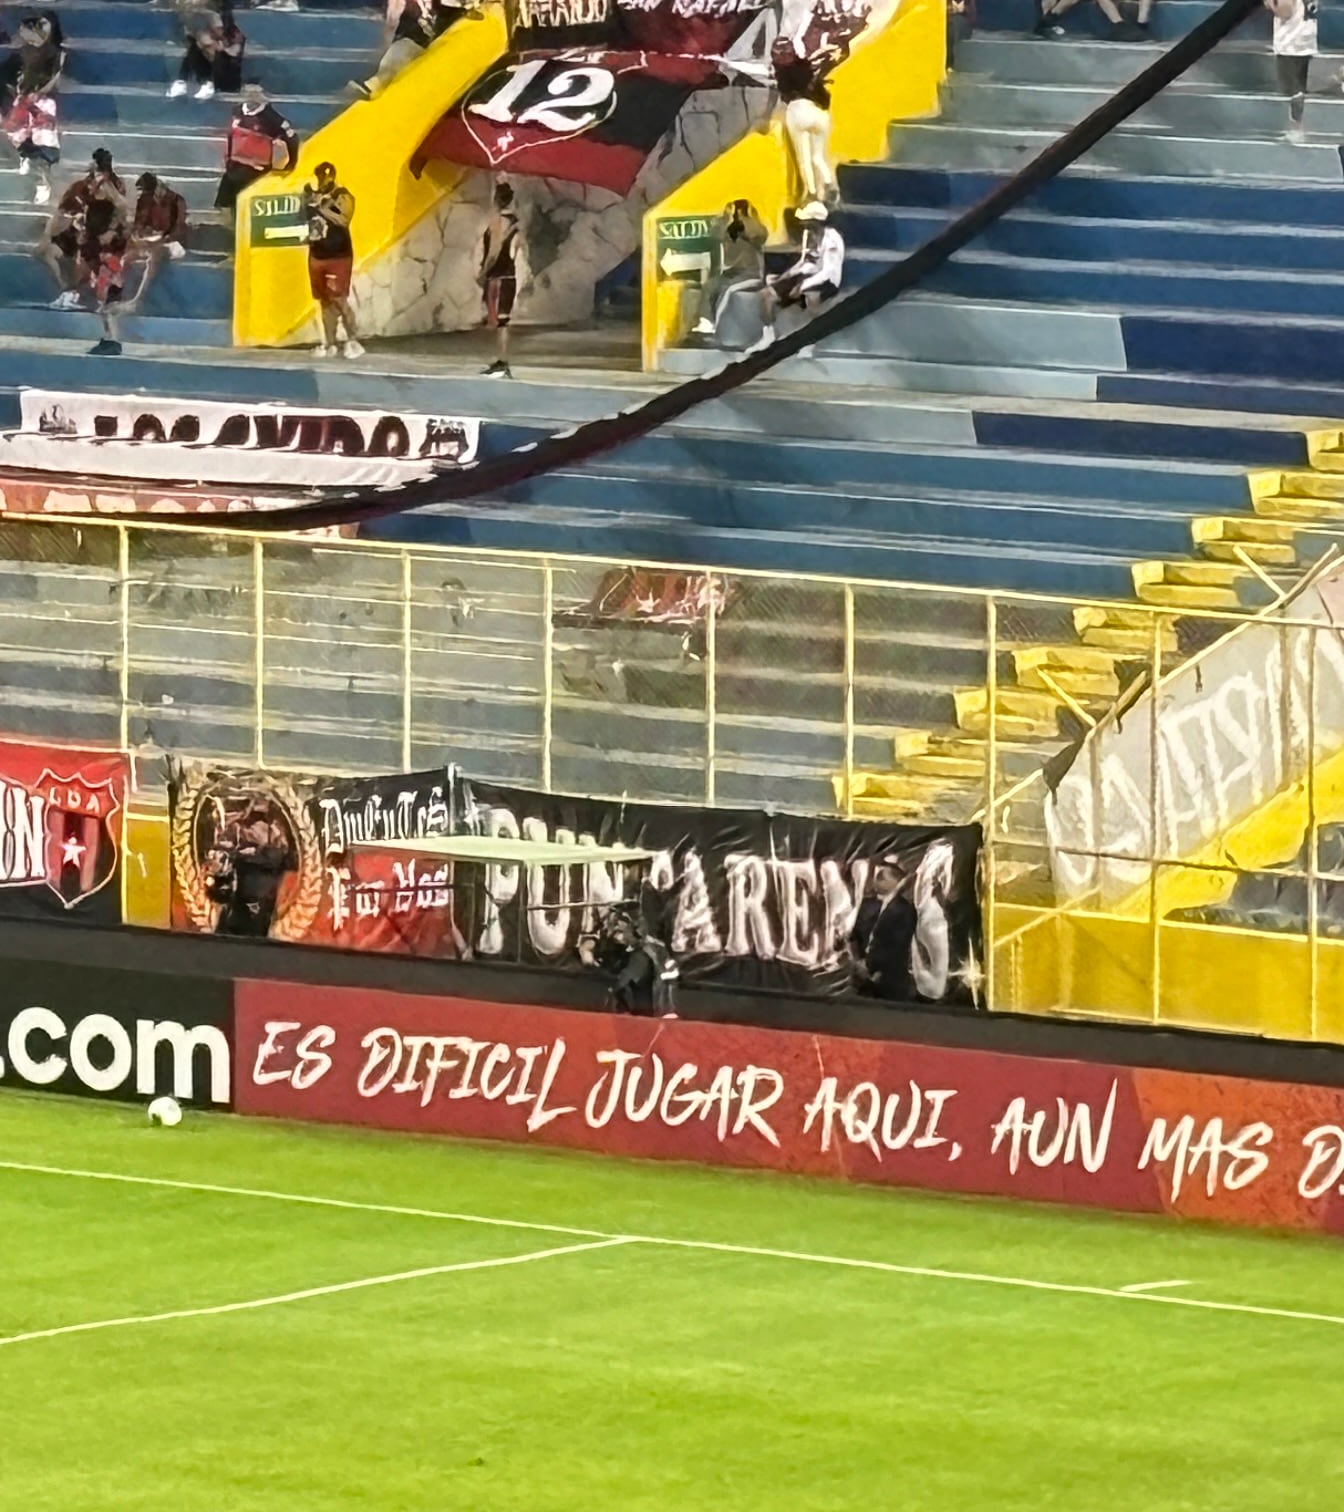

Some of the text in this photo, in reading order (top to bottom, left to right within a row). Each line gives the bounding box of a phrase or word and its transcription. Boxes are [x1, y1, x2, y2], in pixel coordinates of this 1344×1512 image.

[467, 59, 615, 132] 12
[252, 1018, 1344, 1204] ES DIFICIL JUGAR AQUI, AUN MAS D
